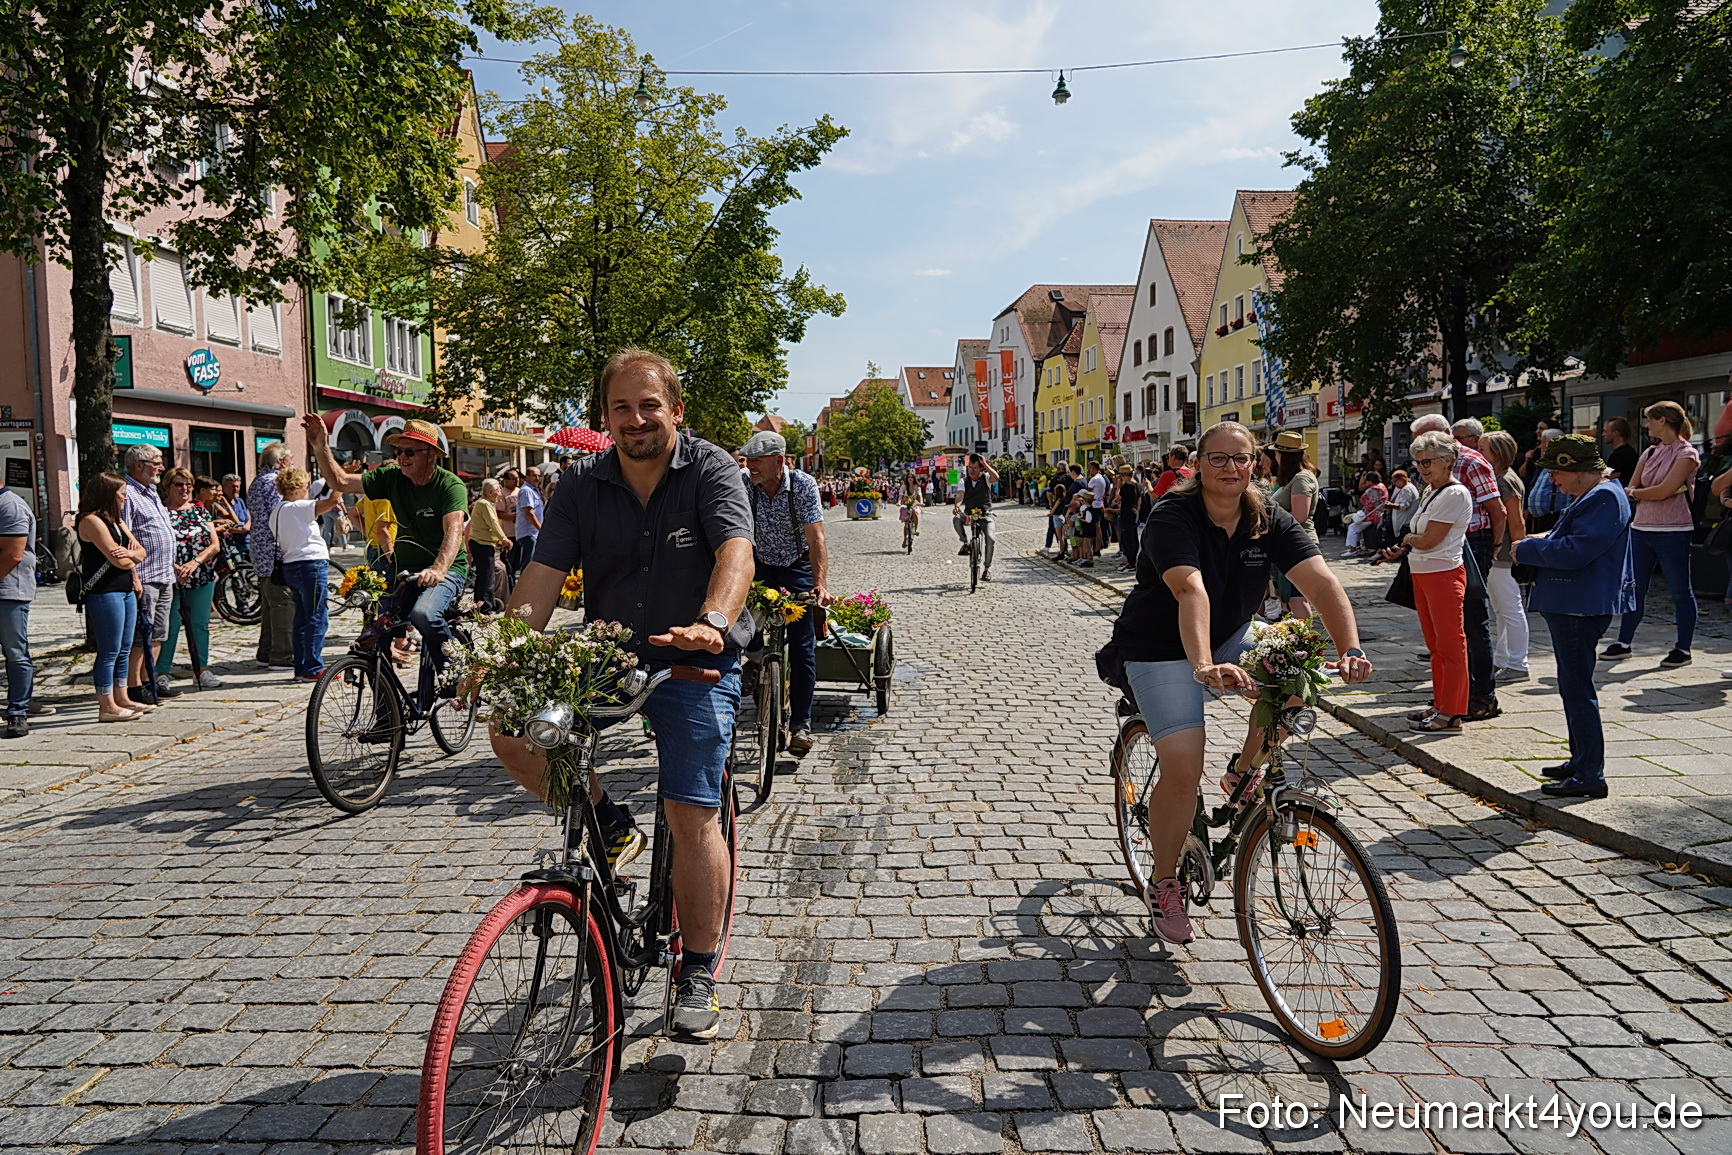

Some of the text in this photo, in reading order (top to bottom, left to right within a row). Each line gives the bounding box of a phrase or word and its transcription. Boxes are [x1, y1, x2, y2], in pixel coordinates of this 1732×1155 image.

[187, 352, 206, 368] vom
[193, 362, 220, 384] FASS
[1003, 372, 1015, 404] SALE
[145, 430, 169, 444] Whisky
